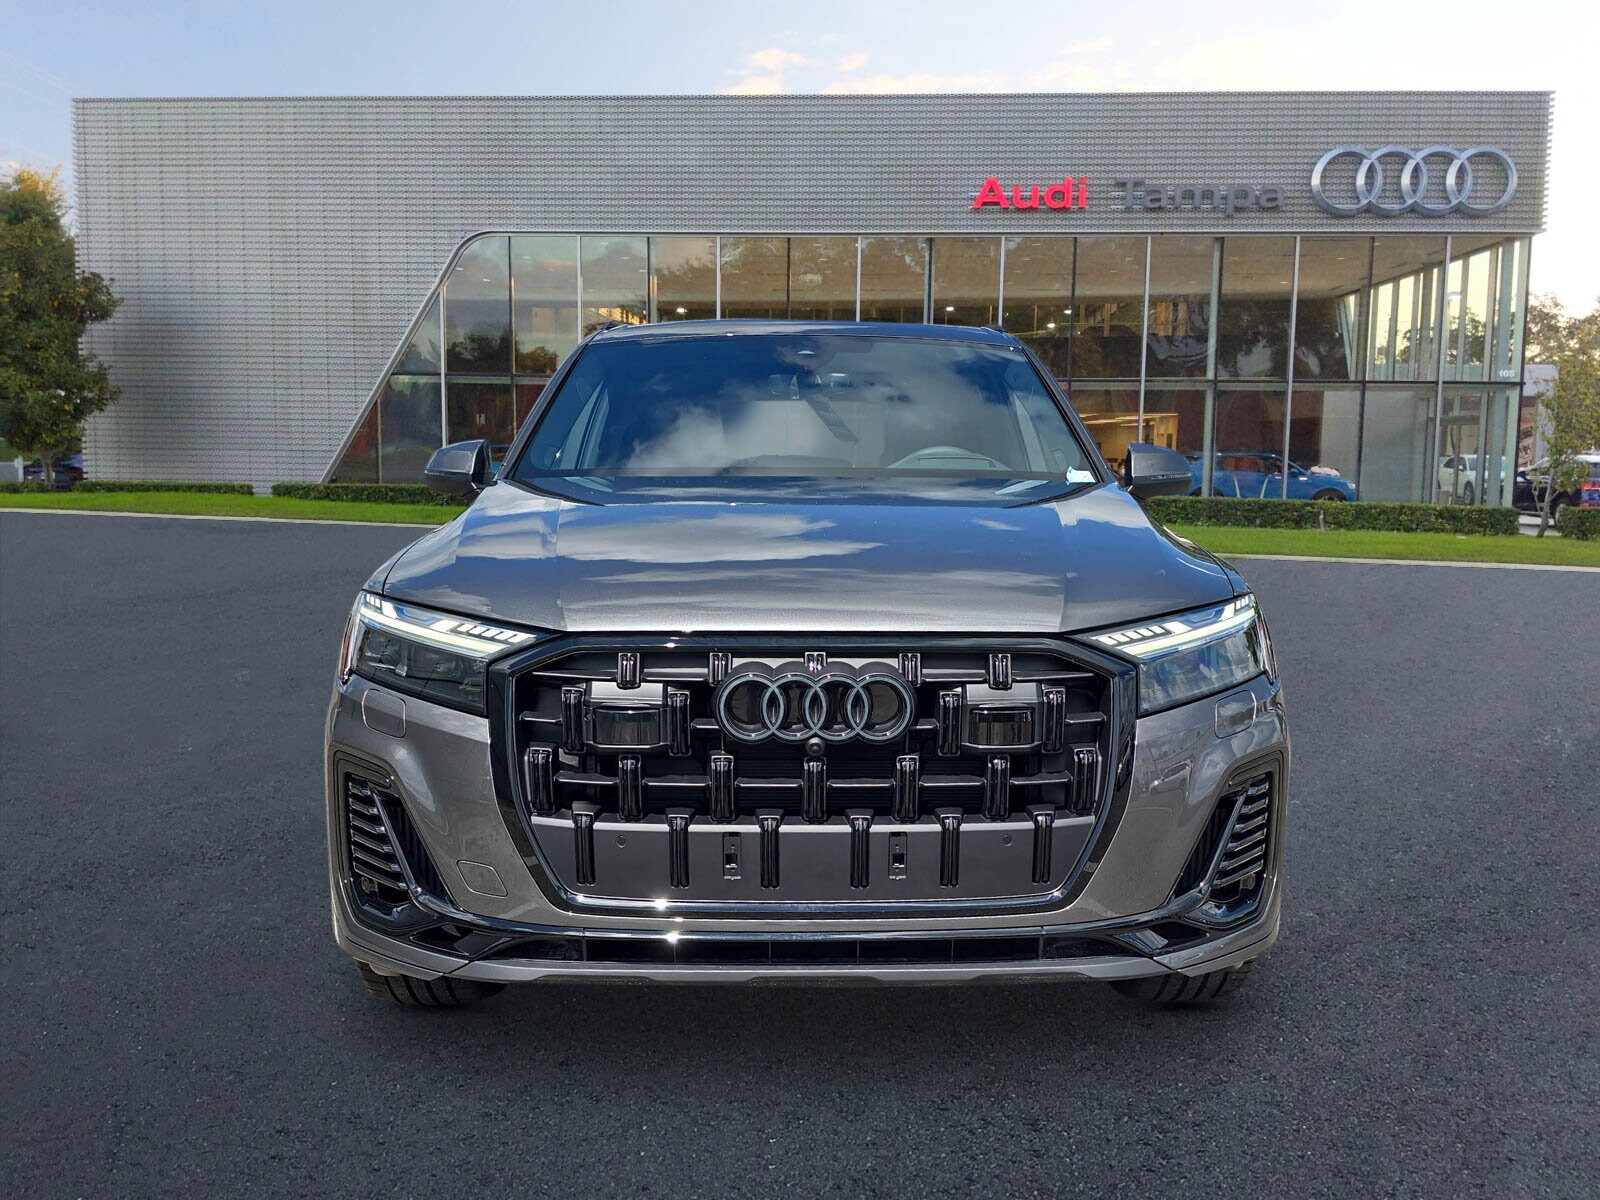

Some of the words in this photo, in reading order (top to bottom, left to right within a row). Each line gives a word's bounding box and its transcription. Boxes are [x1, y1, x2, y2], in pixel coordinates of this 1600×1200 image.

[972, 176, 1088, 210] Audi
[1113, 178, 1284, 217] Tampa
[1499, 369, 1515, 378] 105
